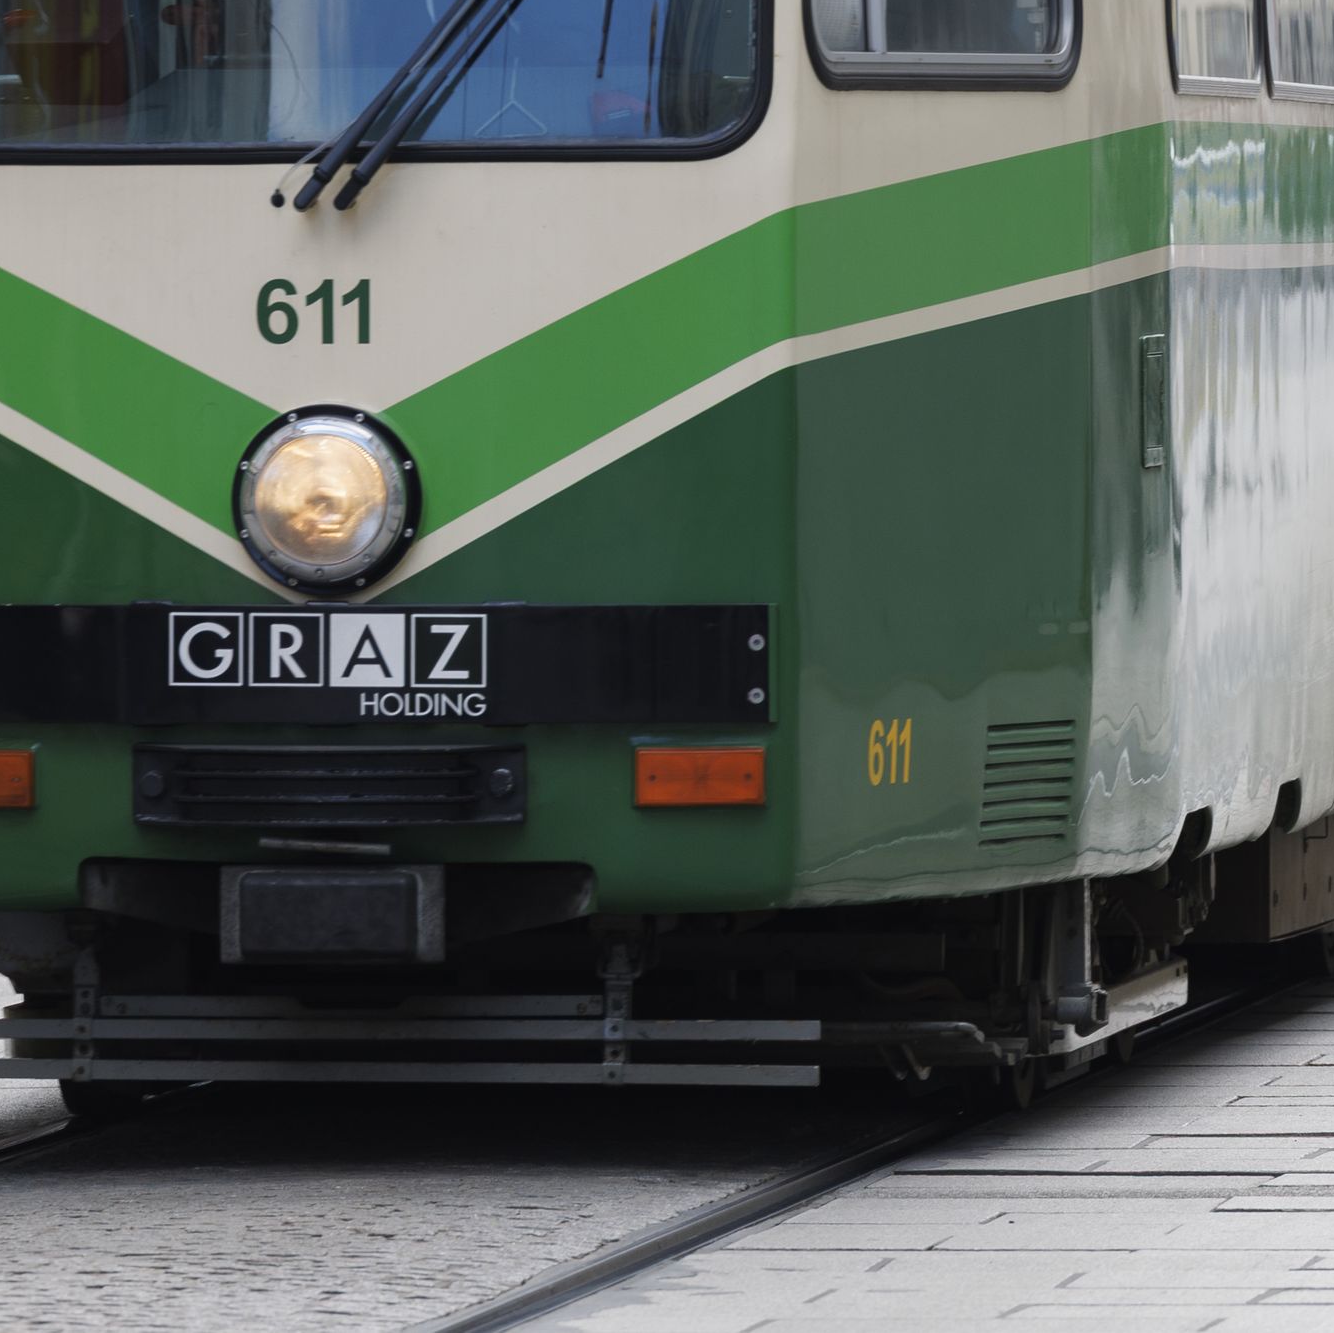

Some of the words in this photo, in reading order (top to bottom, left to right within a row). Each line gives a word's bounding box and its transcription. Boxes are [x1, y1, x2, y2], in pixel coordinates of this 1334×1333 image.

[255, 277, 372, 346] 611
[176, 619, 475, 682] GRAZ
[359, 691, 488, 718] HOLDING
[867, 717, 914, 786] 611
